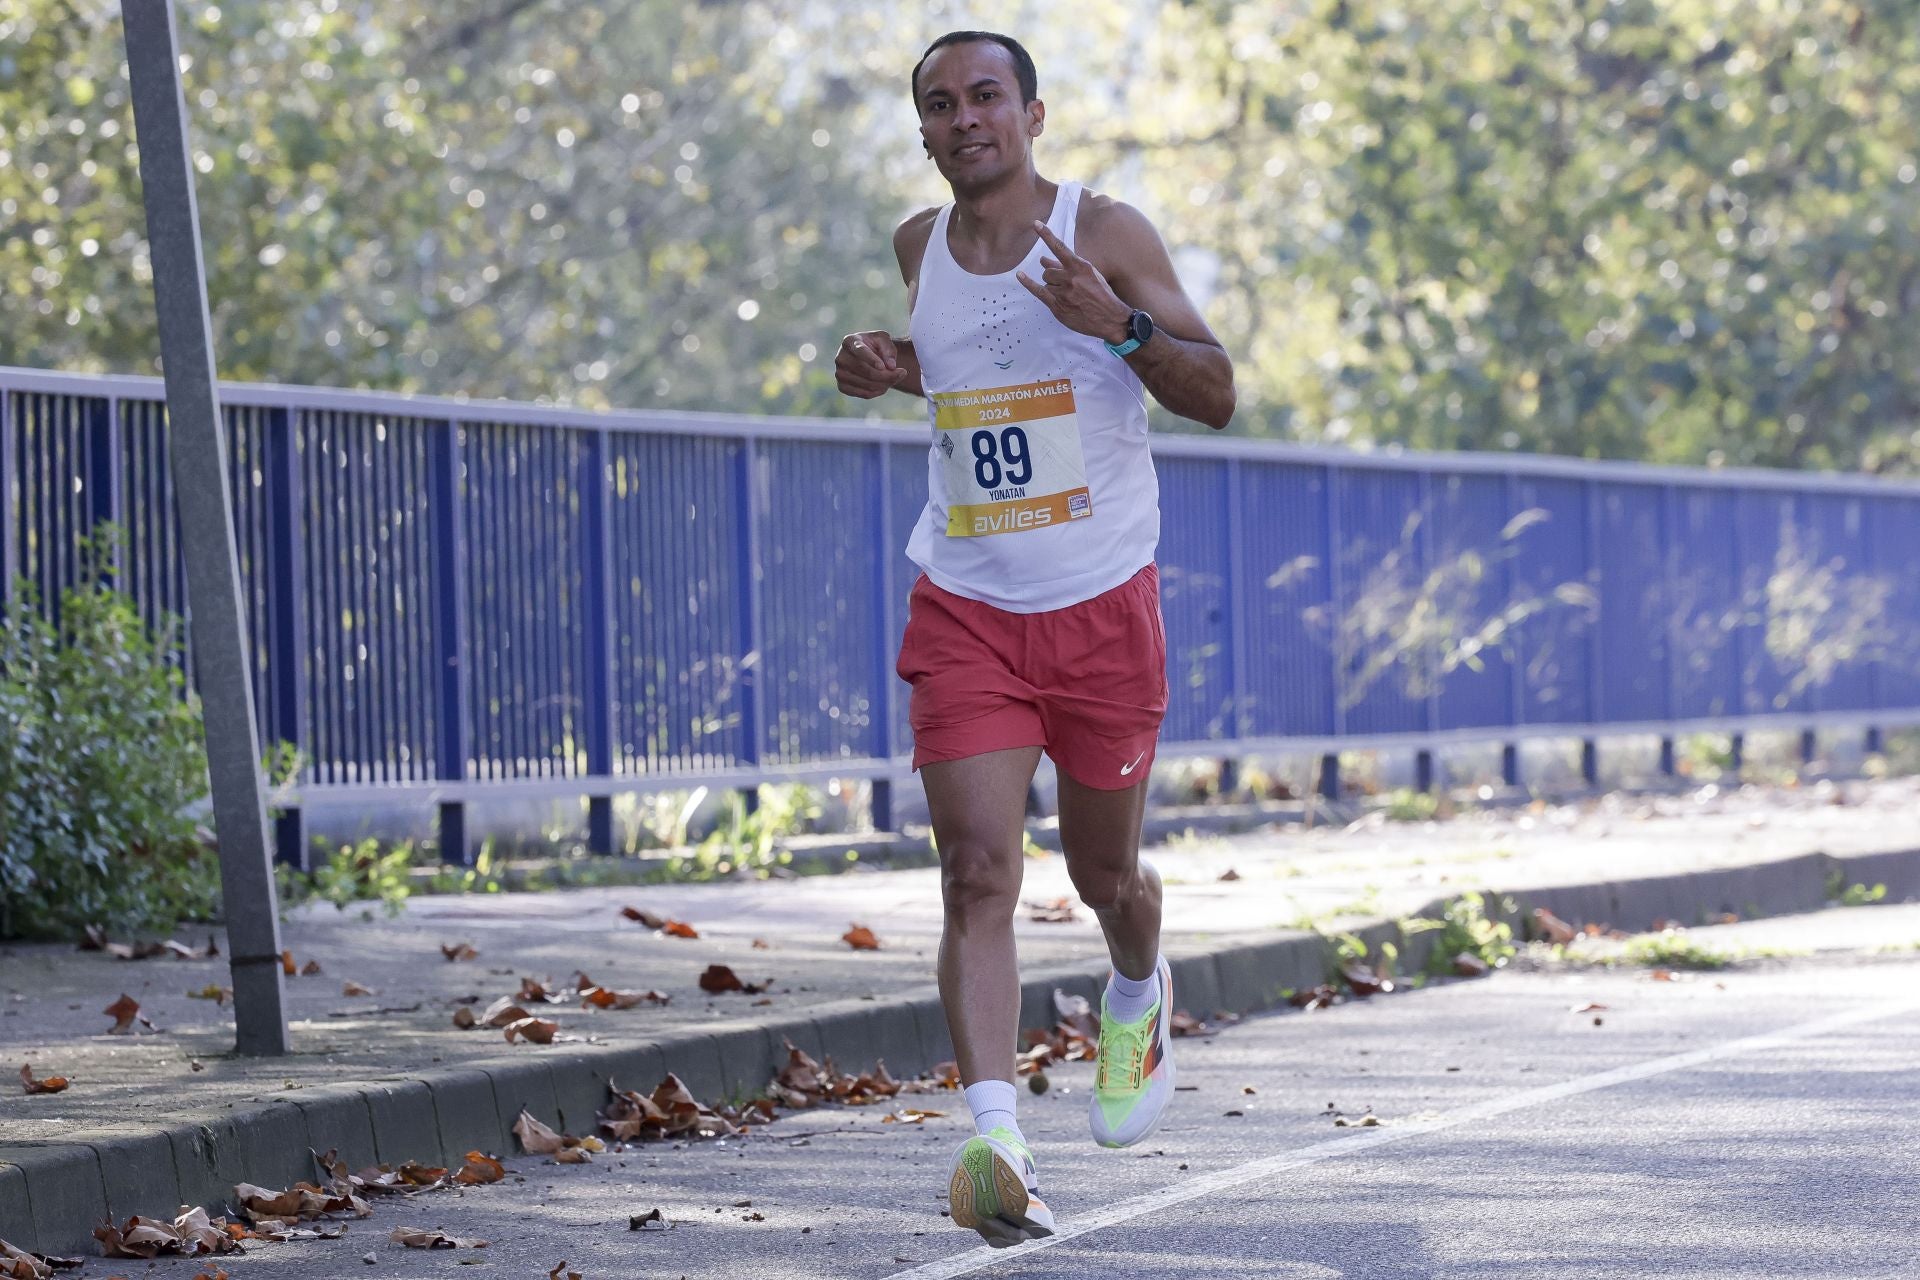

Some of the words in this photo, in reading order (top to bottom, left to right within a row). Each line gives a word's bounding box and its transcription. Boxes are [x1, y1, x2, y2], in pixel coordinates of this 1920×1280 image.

[954, 396, 980, 408] MEDIA
[981, 388, 1032, 405] MARATÓN
[1034, 382, 1069, 398] AVILÉS
[979, 407, 1011, 421] 2024
[971, 426, 1033, 489] 89
[988, 487, 1026, 501] YONATAN
[974, 506, 1052, 533] avilés
